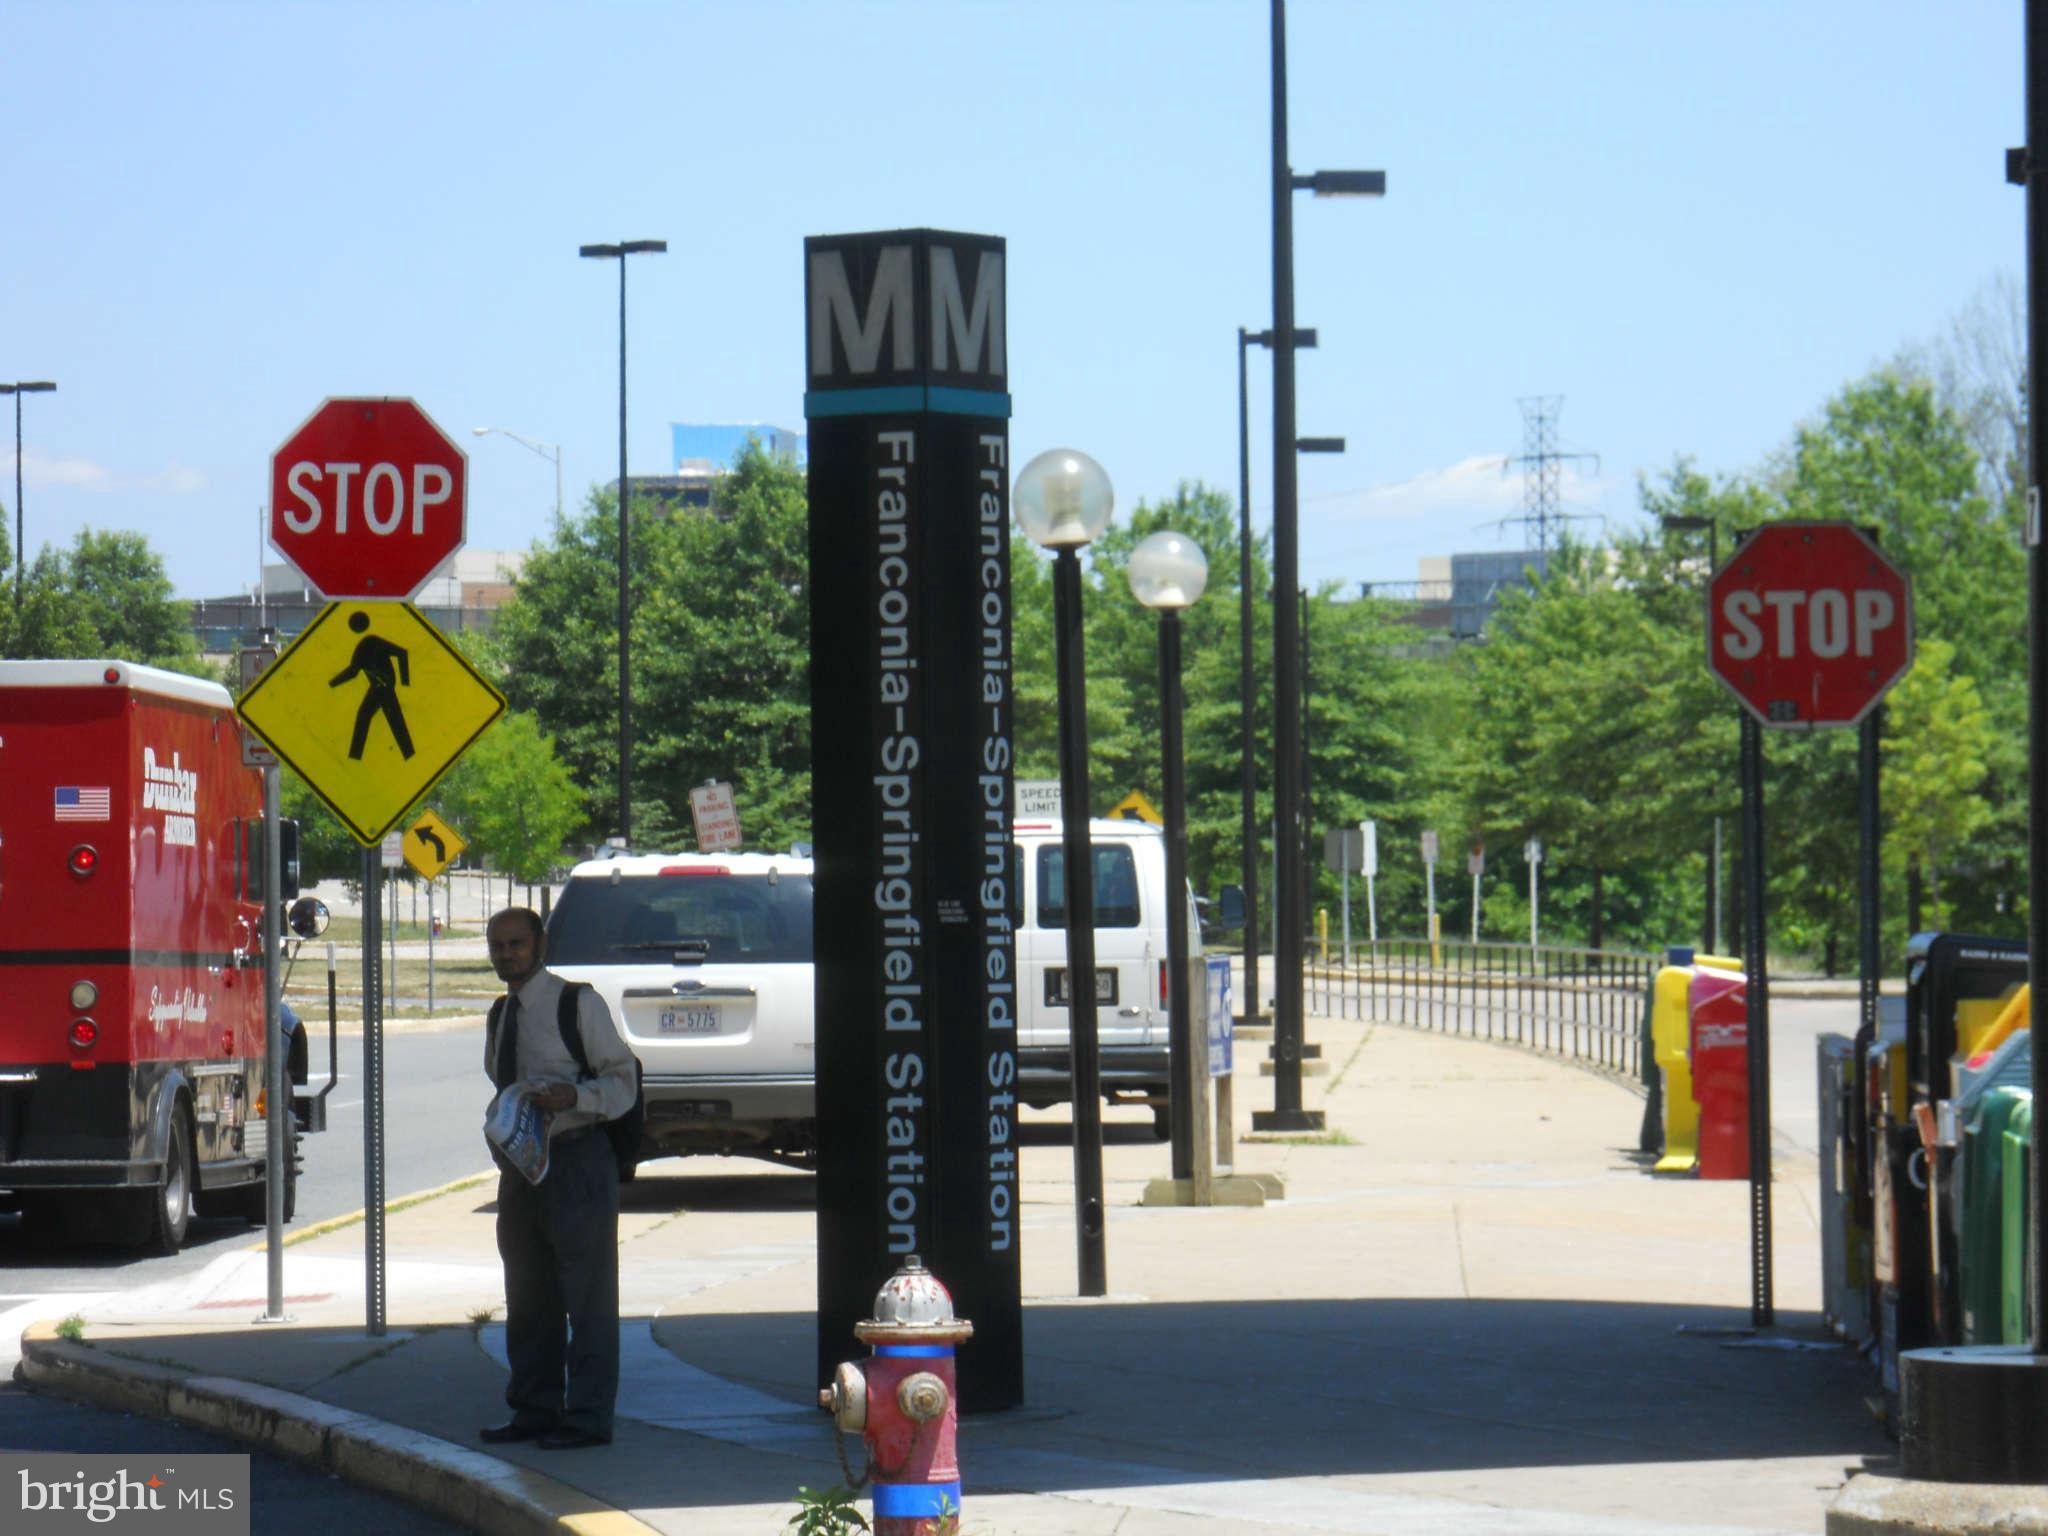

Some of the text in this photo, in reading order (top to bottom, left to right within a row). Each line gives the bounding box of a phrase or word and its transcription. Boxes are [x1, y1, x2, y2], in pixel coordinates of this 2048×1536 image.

[809, 245, 915, 377] M
[929, 245, 1005, 377] M
[283, 460, 454, 536] STOP
[1721, 587, 1896, 661] STOP
[143, 746, 197, 816] Dunbar
[1024, 800, 1056, 813] LIMIT
[873, 430, 924, 1254] Franconia-Springfield Station
[978, 434, 1016, 1252] Franconia-Springfield Station
